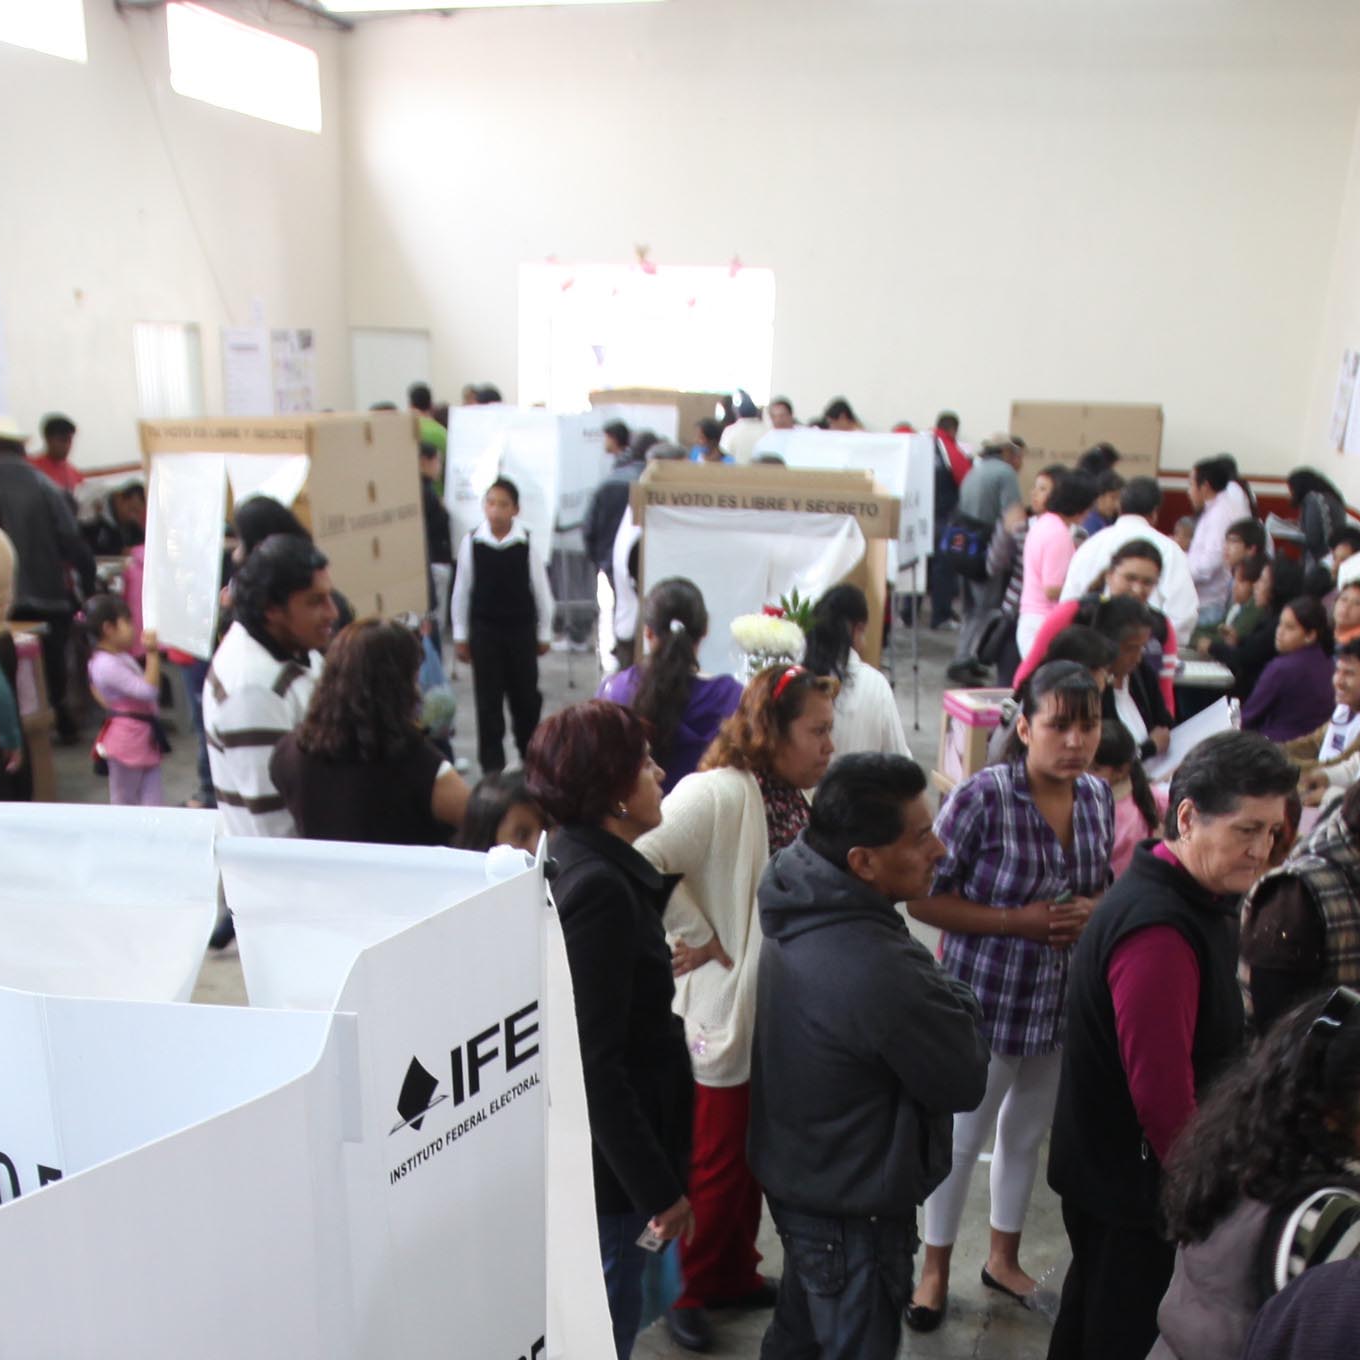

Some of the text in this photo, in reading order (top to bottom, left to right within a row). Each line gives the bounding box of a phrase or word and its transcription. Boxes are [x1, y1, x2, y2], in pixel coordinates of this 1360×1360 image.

[646, 491, 880, 518] TU VOTO ES LIBRE Y SECRETO
[450, 1000, 540, 1108] IFE
[390, 1072, 541, 1185] INSTITUTO FEDERAL ELECTORAL
